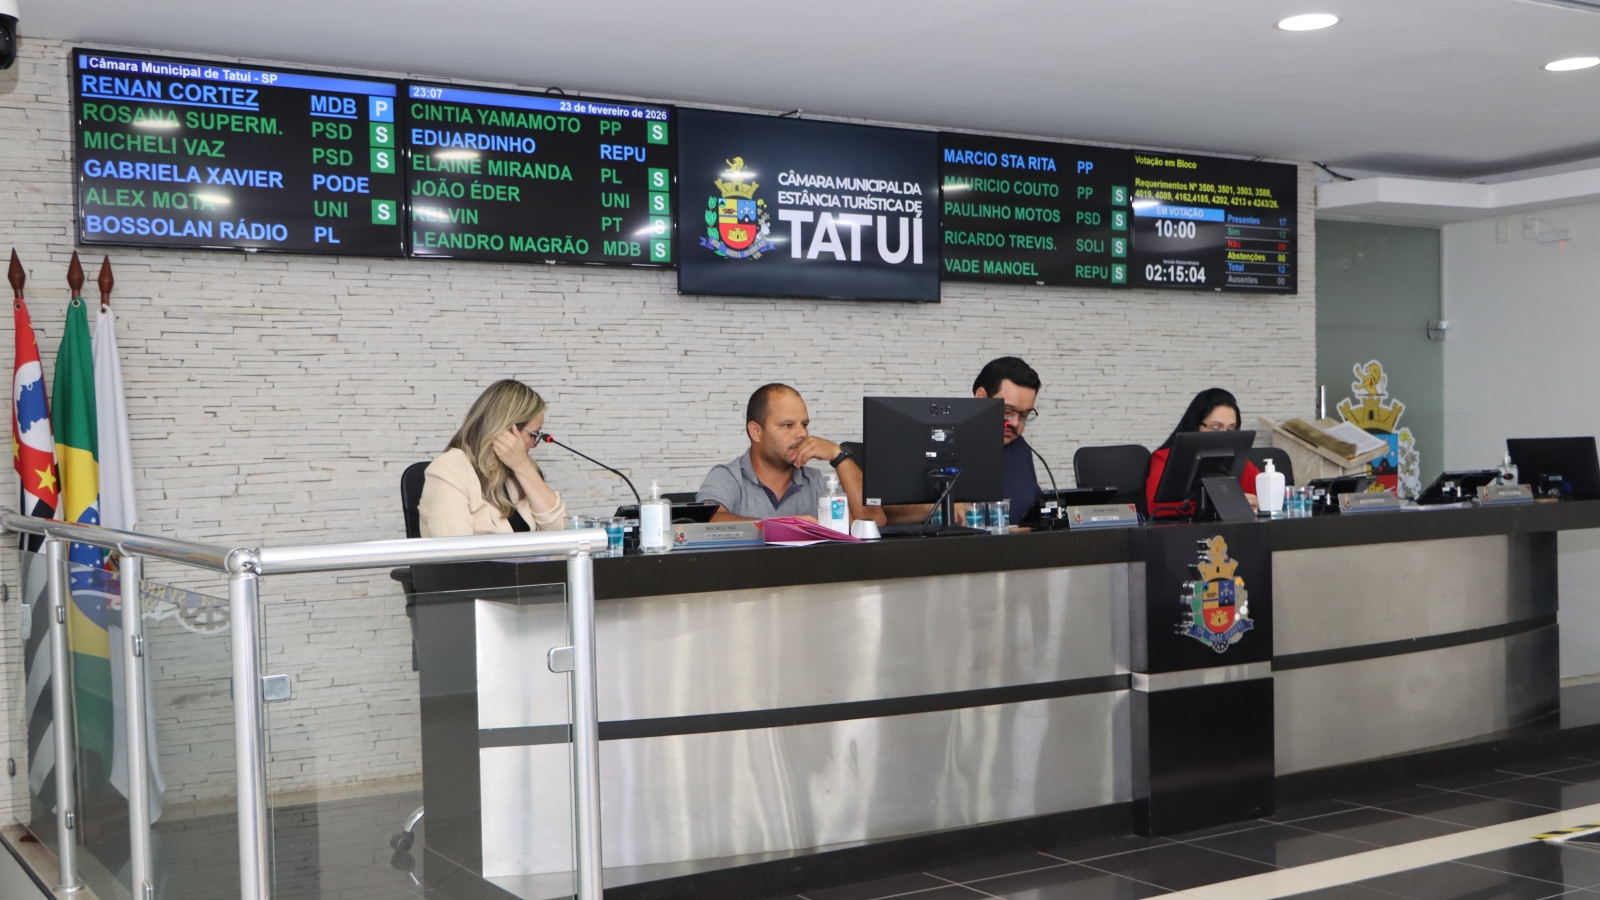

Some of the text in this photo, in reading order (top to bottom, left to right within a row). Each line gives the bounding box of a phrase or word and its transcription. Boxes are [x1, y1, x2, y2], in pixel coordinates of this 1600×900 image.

[89, 57, 138, 72] Câmara
[141, 62, 201, 80] Municipal
[204, 67, 218, 80] de
[222, 69, 251, 82] Tatuí
[261, 72, 278, 84] SP
[82, 75, 259, 107] RENAN CORTEZ
[413, 87, 443, 98] 23:07
[310, 95, 357, 114] MDB
[375, 102, 388, 117] P
[560, 102, 667, 120] 23 de fevereiro de 2026
[82, 103, 283, 135] ROSANA SUPERM.
[411, 104, 581, 133] CINTIA YAMAMOTO
[312, 122, 352, 140] PSD
[375, 126, 388, 144] S
[600, 120, 622, 136] PP
[652, 124, 663, 140] S
[84, 132, 225, 158] MICHELI VAZ
[412, 128, 536, 154] EDUARDINHO
[312, 148, 353, 167] PSD
[376, 152, 389, 170] S
[600, 144, 646, 162] REPU
[944, 149, 1056, 172] MARCIO STA RITA
[412, 154, 573, 182] ELAINE MIRANDA
[1077, 160, 1094, 174] PP
[1135, 156, 1163, 167] Votação
[1176, 159, 1197, 170] Bloco
[84, 160, 284, 188] GABRIELA XAVIER
[601, 168, 622, 184] PL
[654, 172, 664, 187] S
[312, 174, 370, 194] PODE
[412, 178, 520, 202] JOÃO ÉDER
[778, 170, 922, 196] CÂMARA MUNICIPAL DA
[944, 176, 1059, 197] MAURICIO COUTO
[1135, 178, 1188, 190] Requerimentos
[1199, 184, 1216, 194] 3500,
[1218, 184, 1235, 195] 3501,
[86, 188, 216, 212] ALEX MOTA
[601, 192, 630, 208] UNI
[1077, 186, 1093, 199] PP
[1115, 189, 1124, 202] S
[1135, 190, 1154, 199] 4019,
[1155, 190, 1174, 202] 4089,
[1212, 196, 1230, 206] 4202,
[1230, 197, 1246, 206] 4213
[314, 201, 348, 218] UNI
[654, 196, 664, 210] S
[778, 190, 922, 214] ESTÂNCIA TURÍSTICA DE
[377, 204, 390, 221] S
[412, 206, 478, 226] KELVIN
[944, 202, 1061, 222] PAULINHO MOTOS
[1076, 212, 1100, 226] PSD
[1115, 214, 1124, 227] S
[1156, 206, 1204, 218] EM VOTAÇÃO
[1228, 214, 1286, 226] Presentes 17
[86, 215, 288, 242] BOSSOLAN RÁDIO
[602, 217, 623, 232] PT
[654, 220, 665, 234] S
[1155, 220, 1196, 239] 10:00
[314, 226, 340, 244] PL
[778, 209, 924, 264] TATUÍ
[944, 230, 1057, 250] RICARDO TREVIS.
[1228, 228, 1286, 239] Sim 12
[413, 231, 589, 255] LEANDRO MAGRÃO
[603, 241, 642, 257] MDB
[655, 242, 666, 258] S
[1076, 239, 1104, 252] SOLI
[1115, 240, 1124, 254] S
[1228, 240, 1286, 250] Não 00
[1228, 252, 1286, 262] Abstenções 00
[944, 258, 1038, 276] VADE MANOEL
[1075, 266, 1108, 279] REPU
[1115, 266, 1124, 280] S
[1145, 264, 1206, 283] 02:15:04
[1228, 262, 1286, 274] Total 12
[1228, 275, 1258, 284] Ausentes
